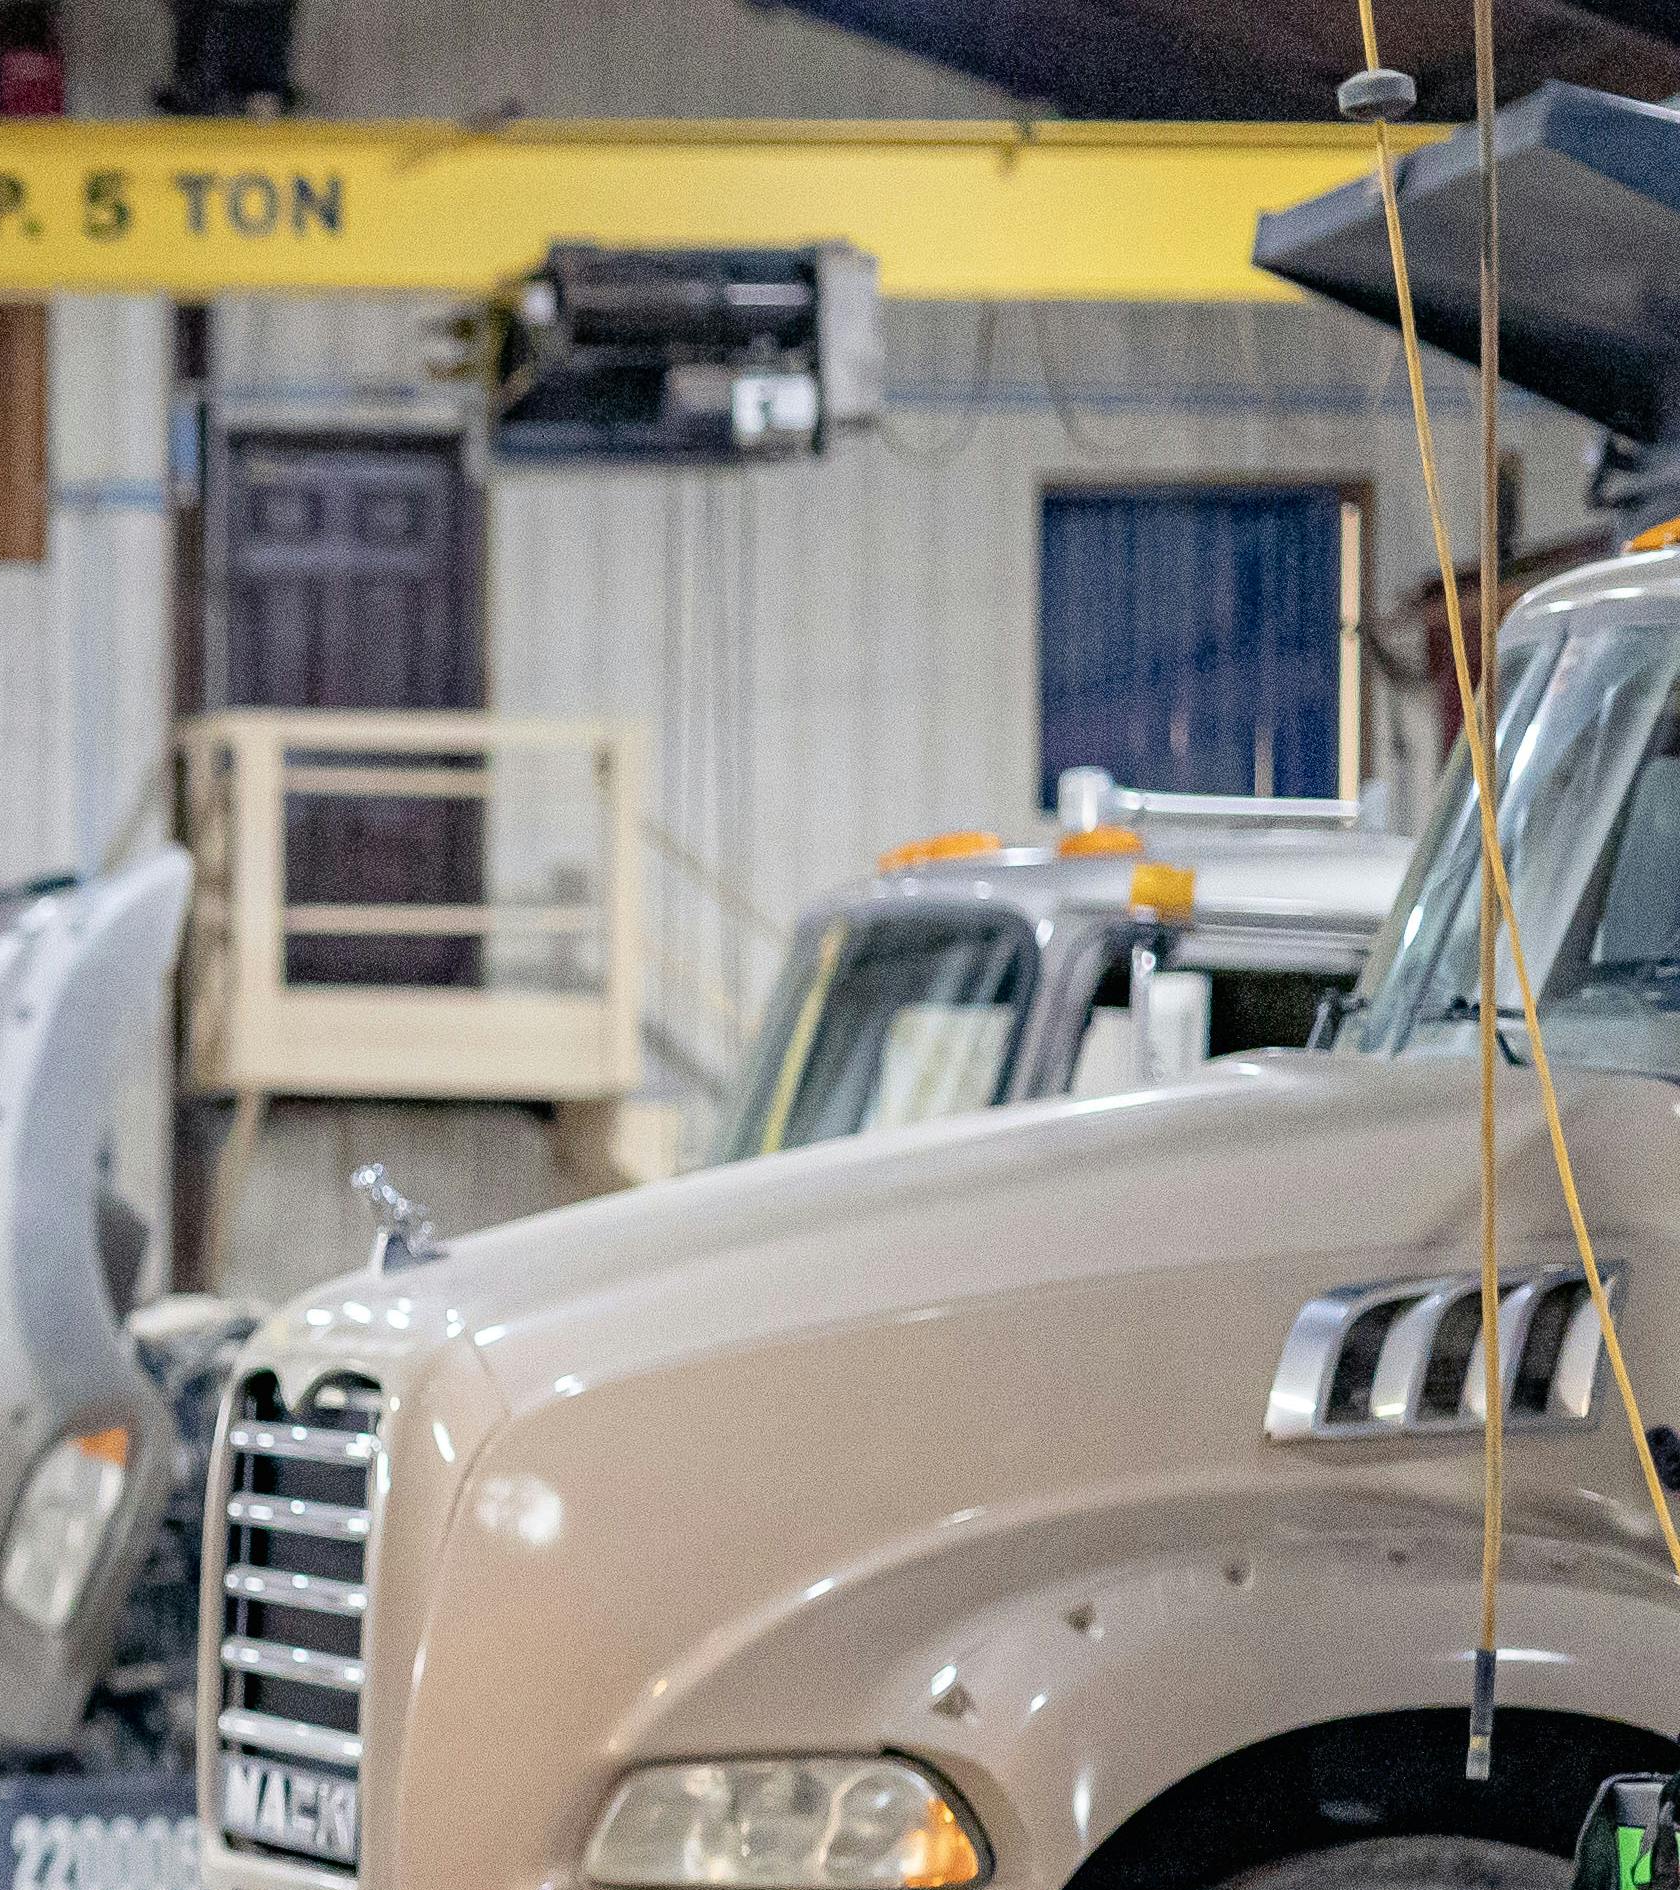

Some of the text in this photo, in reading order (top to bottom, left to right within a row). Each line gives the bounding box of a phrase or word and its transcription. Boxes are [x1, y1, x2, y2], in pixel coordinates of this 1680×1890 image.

[81, 168, 133, 242] 5
[171, 169, 344, 238] TON
[224, 1758, 351, 1857] MACK
